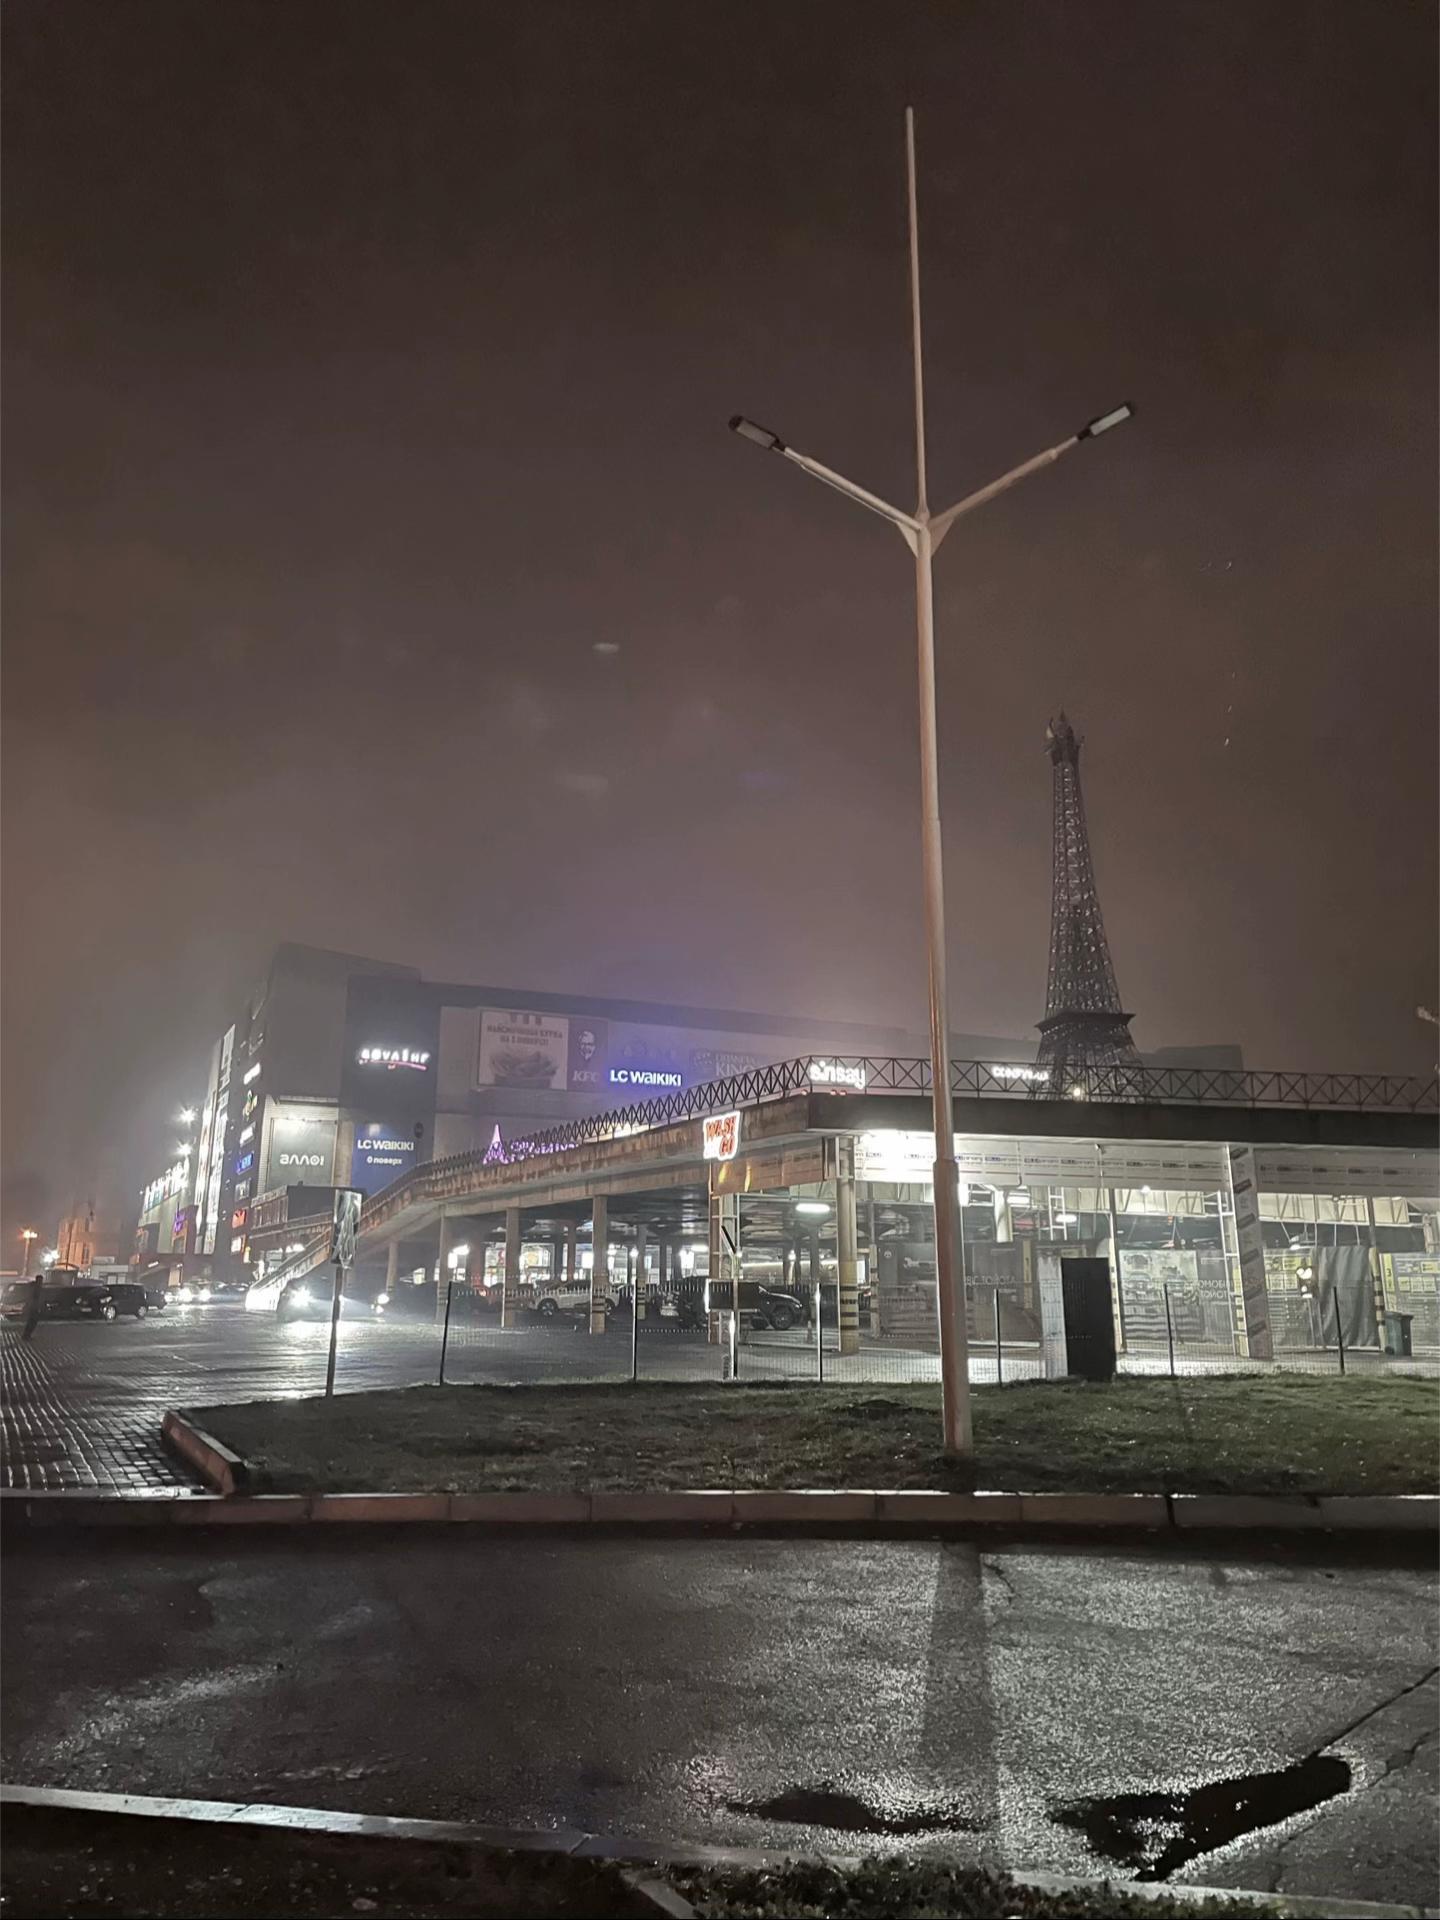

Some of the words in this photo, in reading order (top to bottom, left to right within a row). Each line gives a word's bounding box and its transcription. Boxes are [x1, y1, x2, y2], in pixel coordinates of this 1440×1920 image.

[573, 1069, 601, 1082] KFC
[610, 1069, 628, 1083] LC
[809, 1060, 866, 1090] sinsay
[357, 1139, 371, 1150] LC
[373, 1156, 403, 1166] поверх
